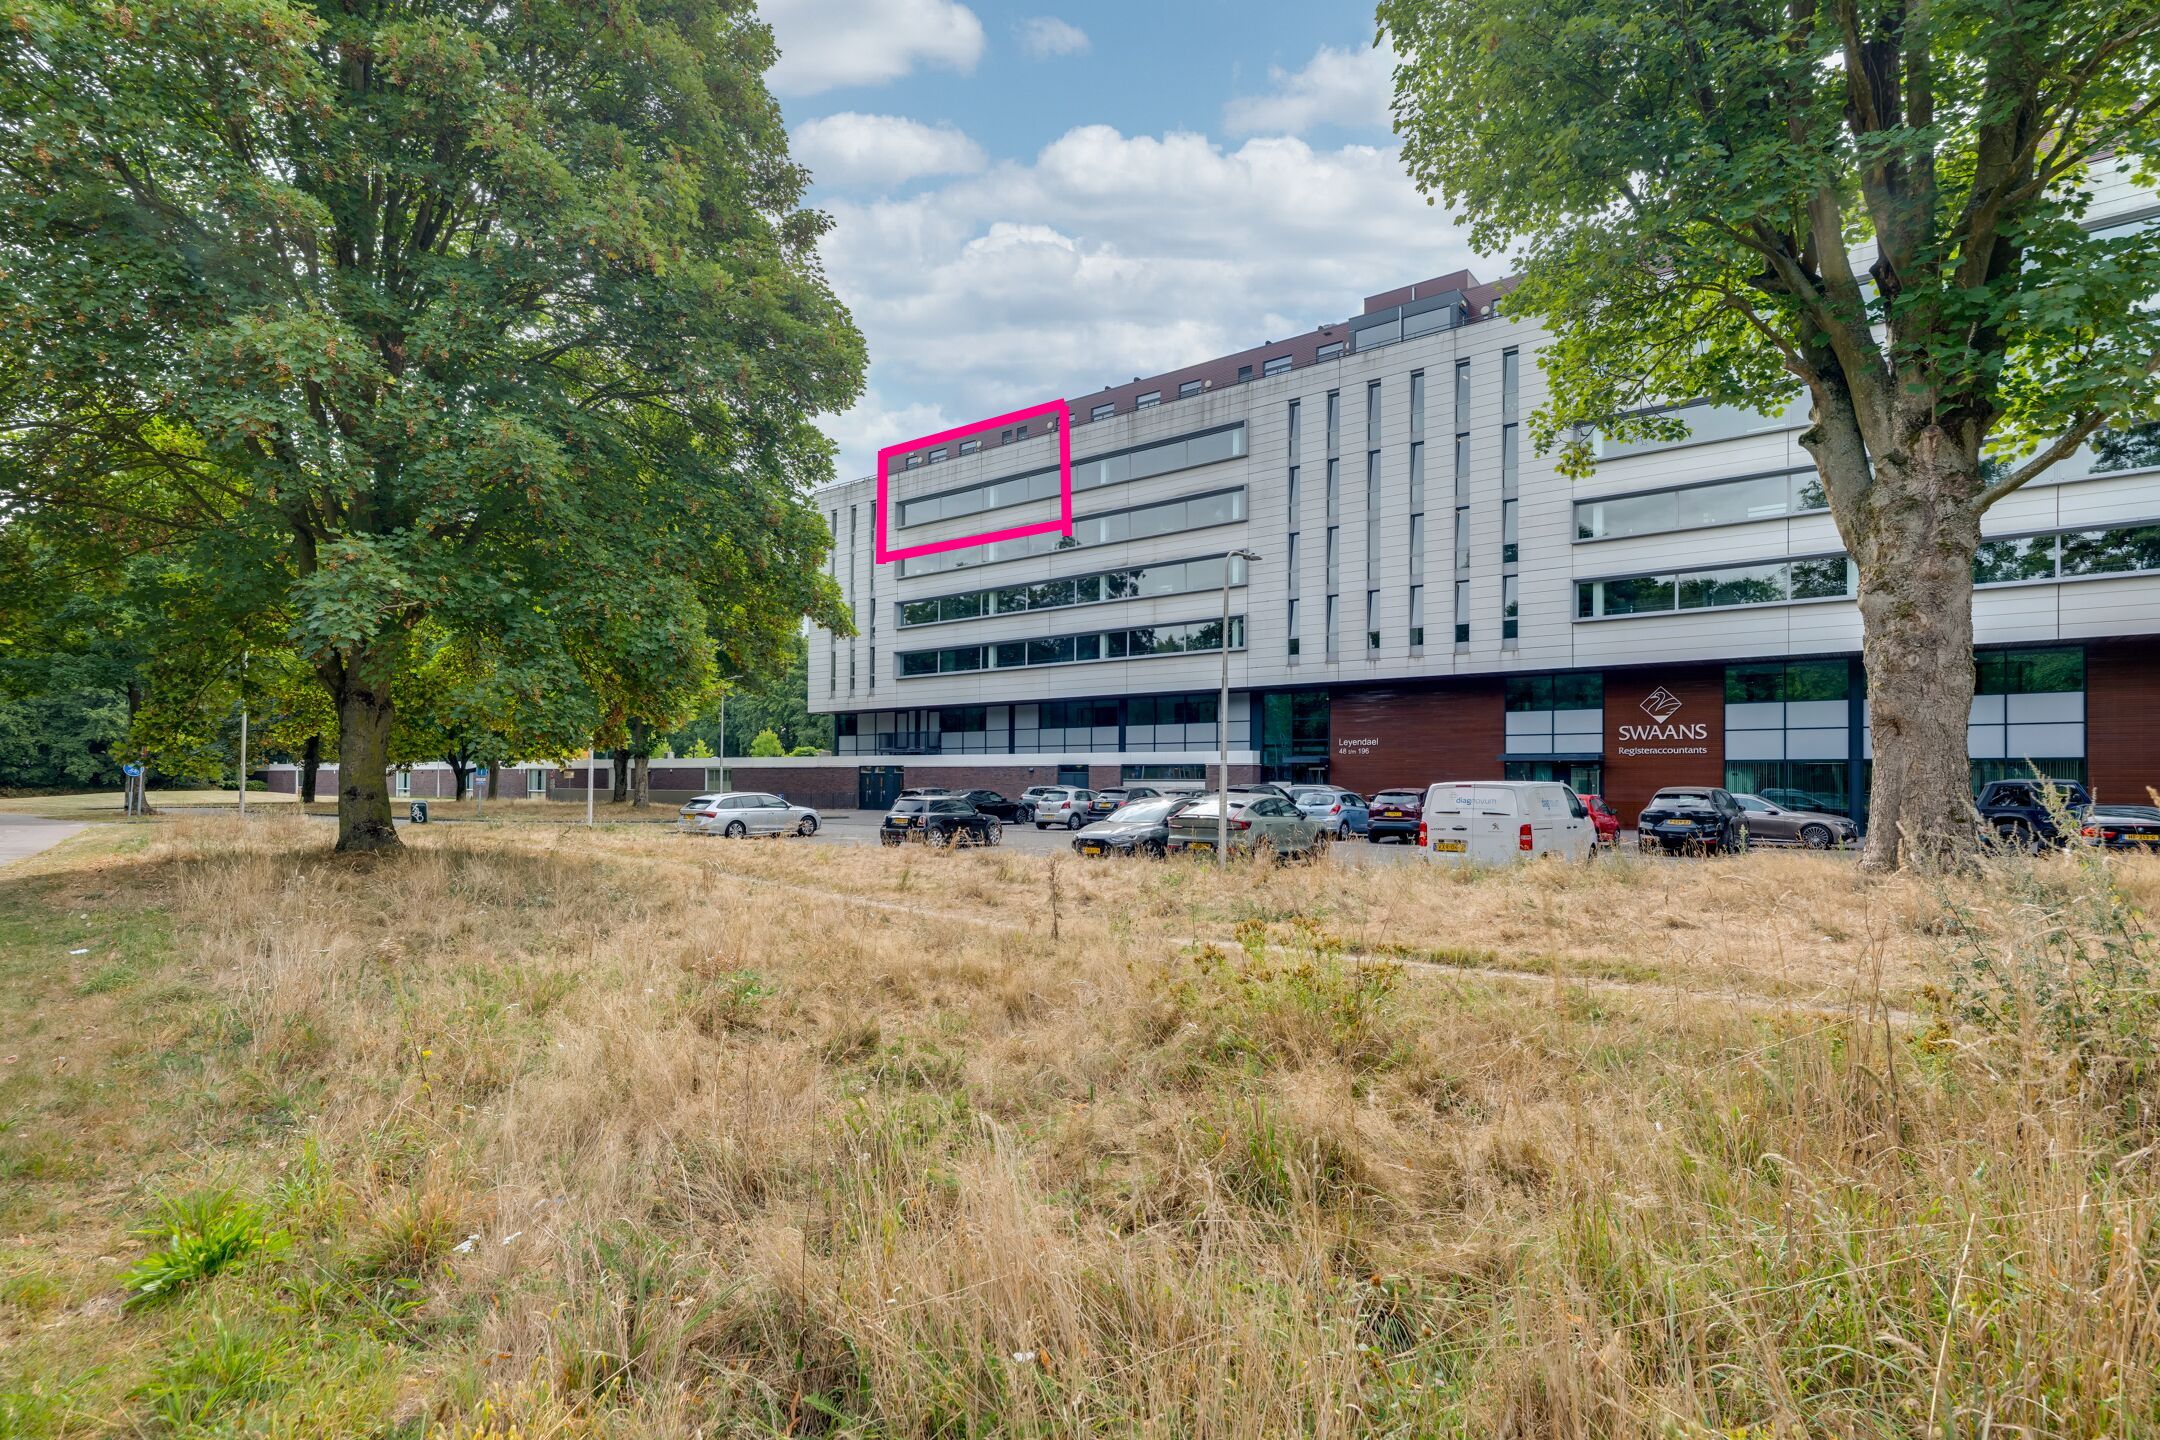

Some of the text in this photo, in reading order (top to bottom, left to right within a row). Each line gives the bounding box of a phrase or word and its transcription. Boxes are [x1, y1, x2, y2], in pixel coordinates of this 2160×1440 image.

[1618, 723, 1708, 741] SWAANS
[1338, 737, 1379, 748] Leyendael
[1338, 747, 1347, 755] 48
[1358, 747, 1370, 755] 196
[1618, 746, 1708, 757] Registeraccountants
